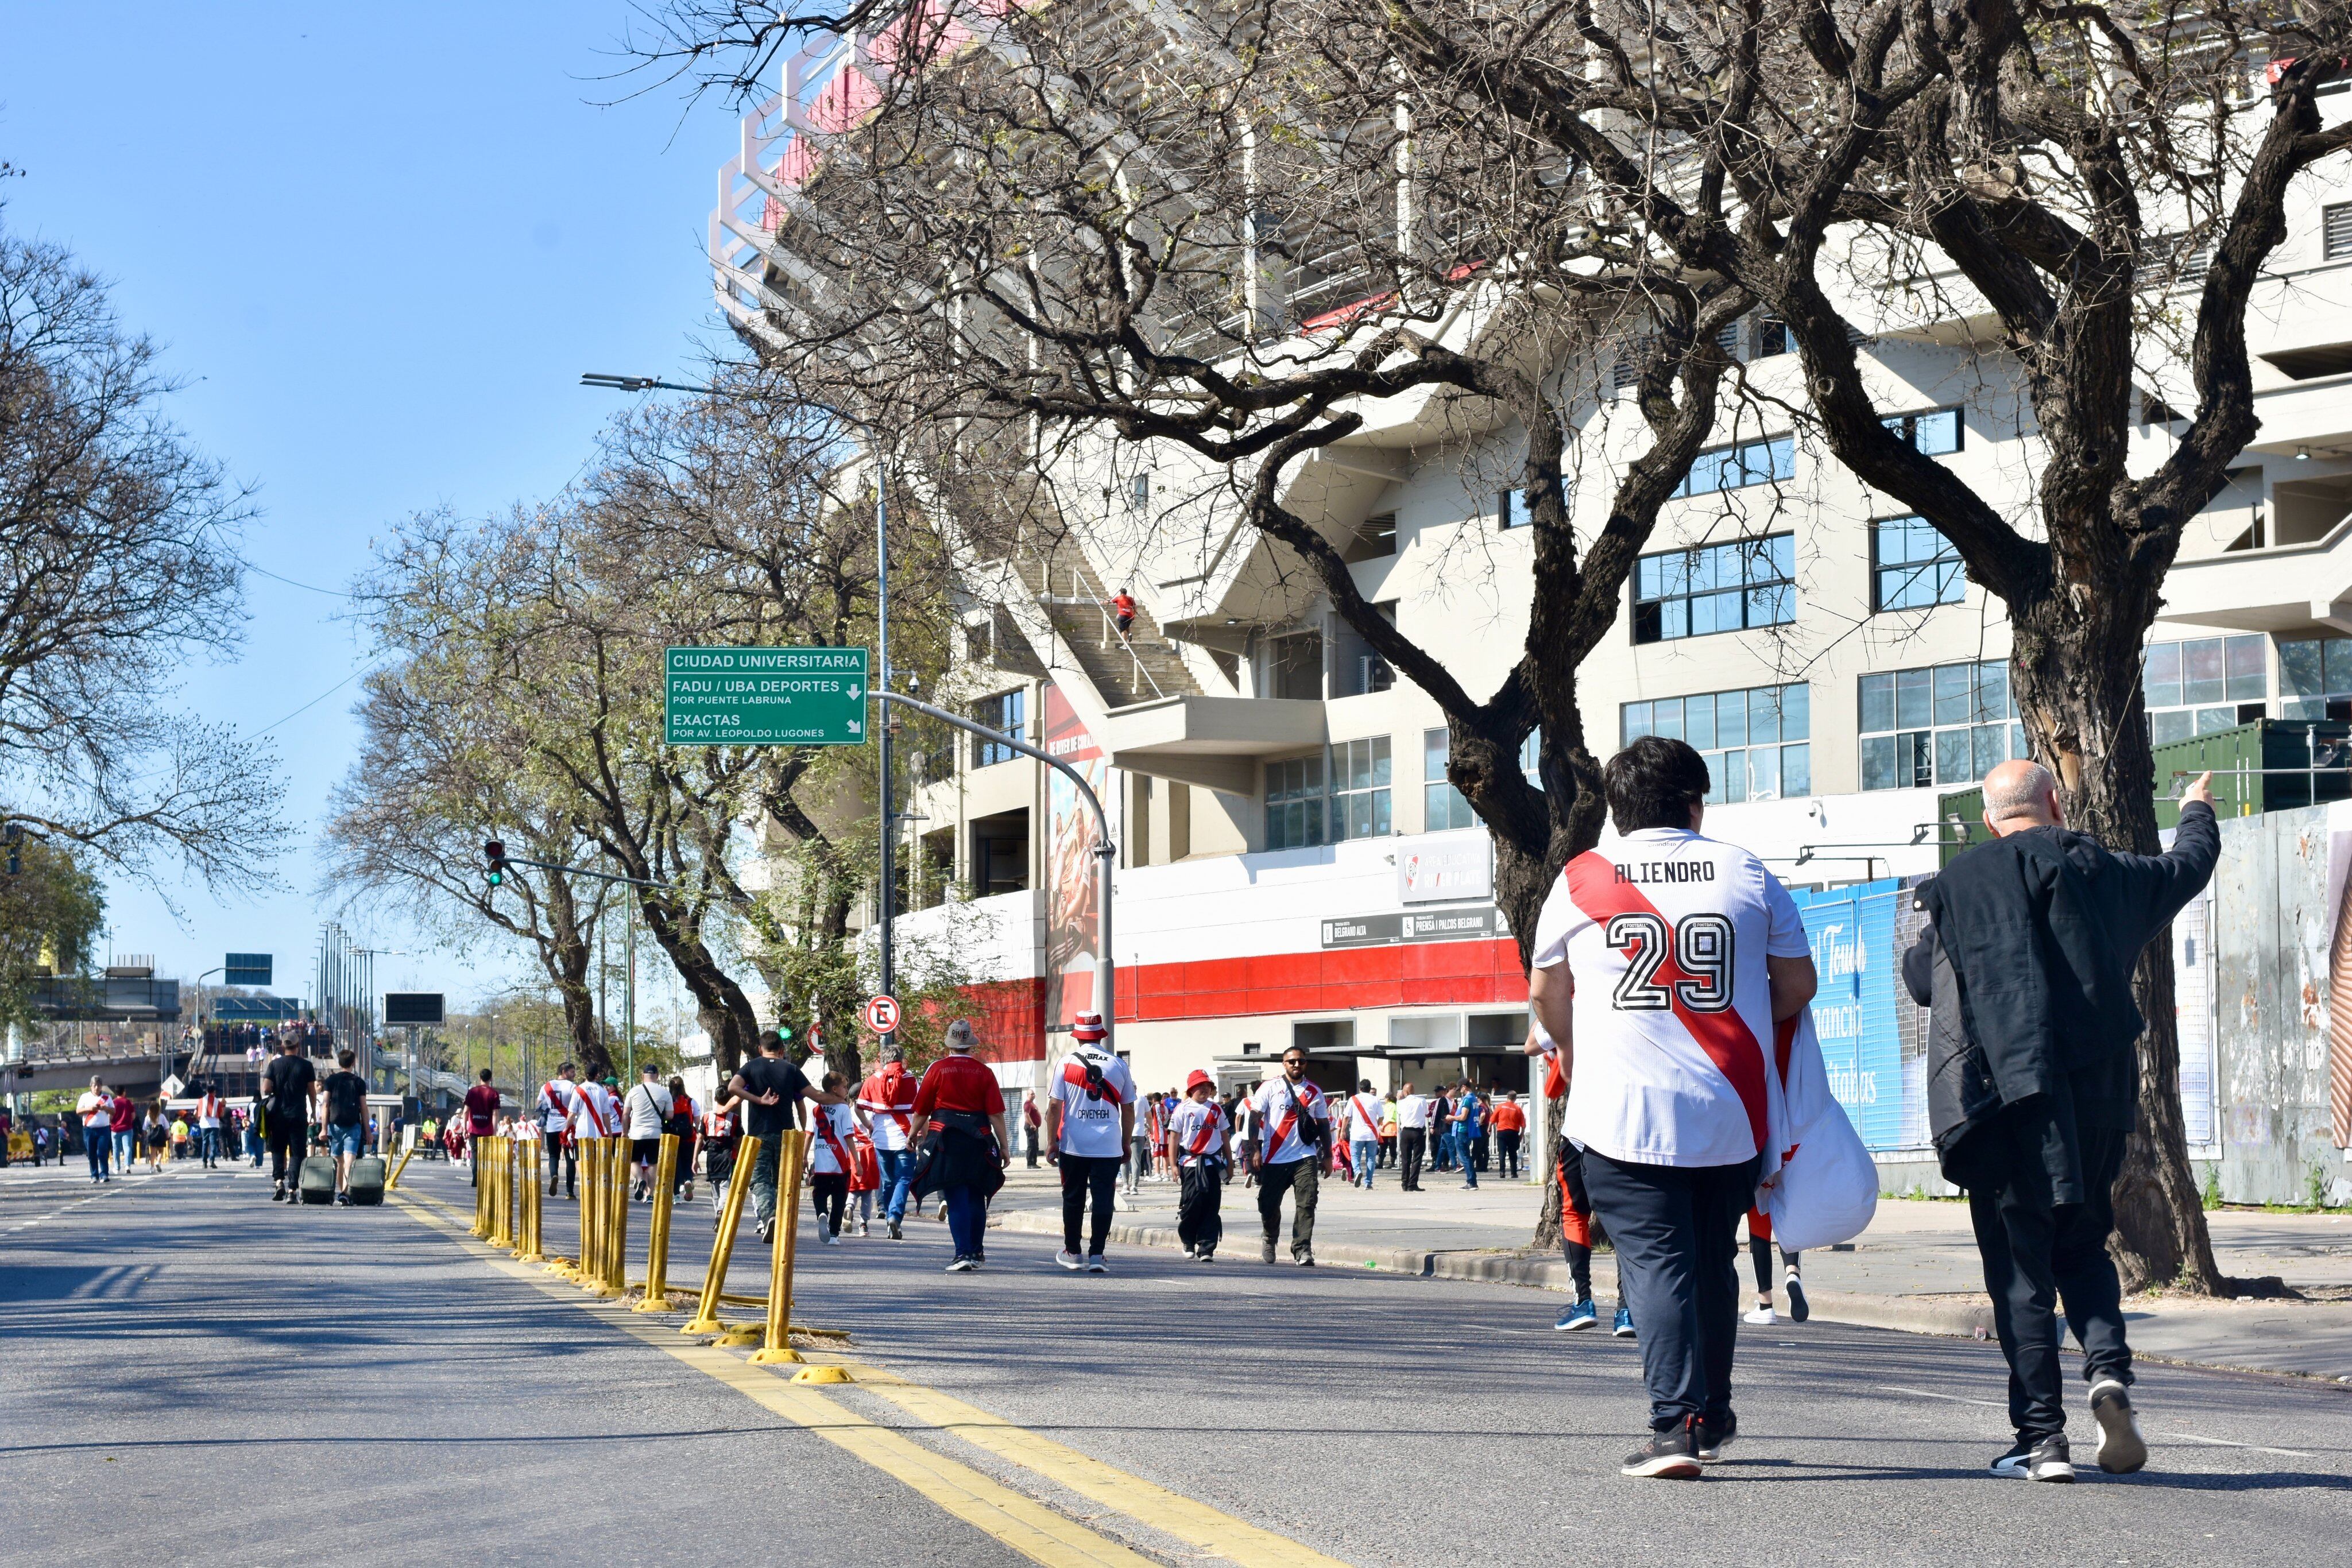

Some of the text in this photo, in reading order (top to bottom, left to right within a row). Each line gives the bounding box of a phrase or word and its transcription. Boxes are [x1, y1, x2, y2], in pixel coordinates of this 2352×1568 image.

[673, 655, 860, 667] CIUDAD UNIVERSITARIA
[673, 681, 840, 692] FADU / UBA DEPORTES
[673, 696, 791, 704] POR PUENTE LABRUNA
[673, 714, 740, 726] EXACTAS
[673, 729, 824, 737] POR AV. LEOPOLDO LUGONES
[1050, 741, 1056, 756] DE
[1056, 738, 1070, 756] RIVER
[1070, 736, 1077, 752] DE
[1442, 853, 1481, 866] EDUCATIVA
[1424, 869, 1482, 888] RIVER PLATE
[1614, 861, 1715, 884] ALIENDRO
[1416, 920, 1435, 931] PRENSA
[1438, 918, 1457, 930] PALCOS
[1457, 916, 1483, 928] BELGRANO
[1334, 925, 1367, 938] BELGRANO ALTA
[1823, 923, 1866, 984] Touch
[1606, 912, 1735, 1012] 29
[877, 1004, 890, 1024] E
[1813, 992, 1863, 1044] gancia
[1085, 1017, 1098, 1025] RIVER
[951, 1029, 970, 1039] RIVER
[1082, 1053, 1109, 1062] UBRAX
[1827, 1058, 1877, 1104] itabas
[1078, 1109, 1109, 1119] CAVENAGHI
[818, 1118, 835, 1139] 21
